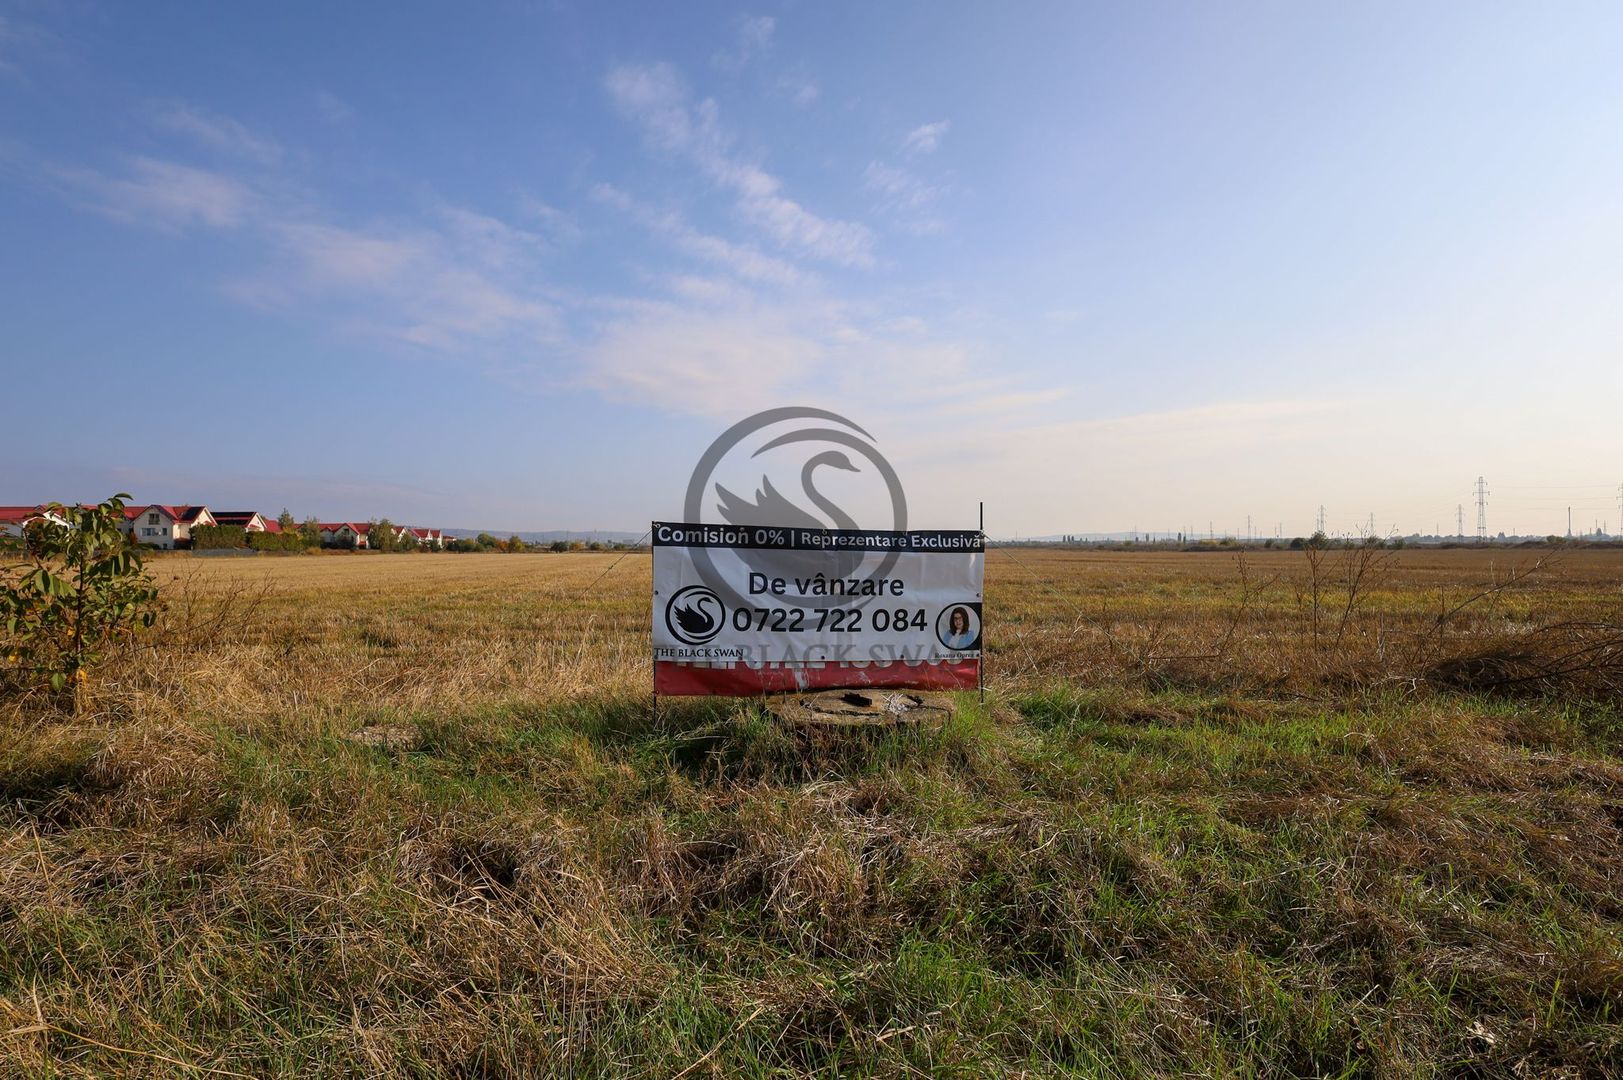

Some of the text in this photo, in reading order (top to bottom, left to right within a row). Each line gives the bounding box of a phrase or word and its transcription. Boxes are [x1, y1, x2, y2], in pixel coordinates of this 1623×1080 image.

[755, 529, 785, 546] 0%
[801, 531, 907, 549] Reprezentare
[911, 534, 981, 549] Exclusivă
[749, 572, 905, 597] De vânzare
[732, 608, 928, 632] 0722 722 084
[654, 647, 744, 658] THE BLACK SWAN
